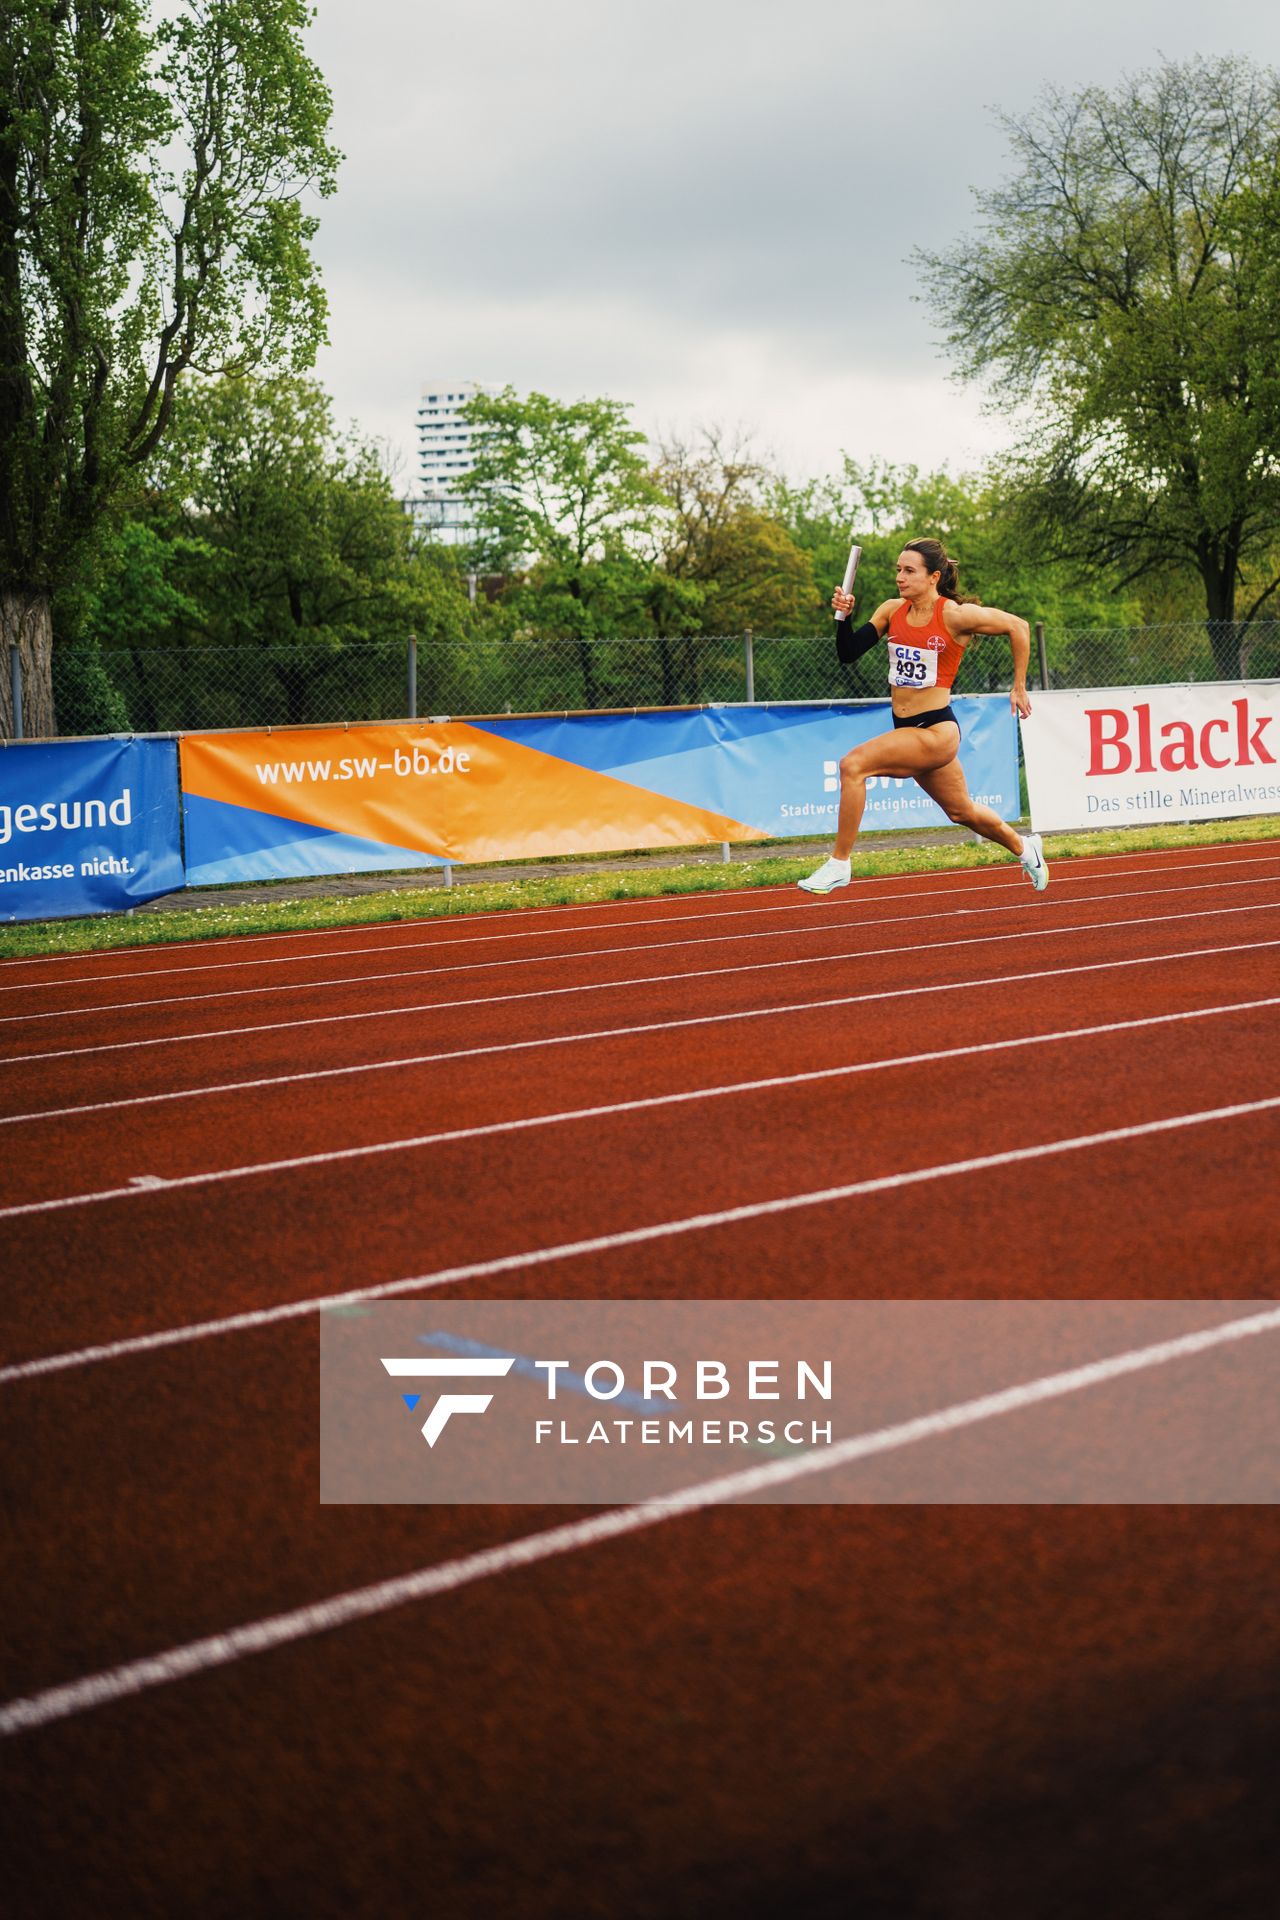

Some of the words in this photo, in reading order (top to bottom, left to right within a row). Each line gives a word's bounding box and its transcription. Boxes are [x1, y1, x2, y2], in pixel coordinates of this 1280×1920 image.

[895, 647, 921, 662] GLS
[896, 660, 927, 680] 493
[1084, 698, 1277, 776] Black
[255, 746, 471, 785] www.sw-bb.de
[780, 802, 841, 817] Stadtwer
[1087, 795, 1120, 813] Das
[1126, 790, 1173, 810] stille
[0, 788, 132, 845] gesund
[0, 862, 75, 884] enkasse
[81, 855, 135, 877] nicht.
